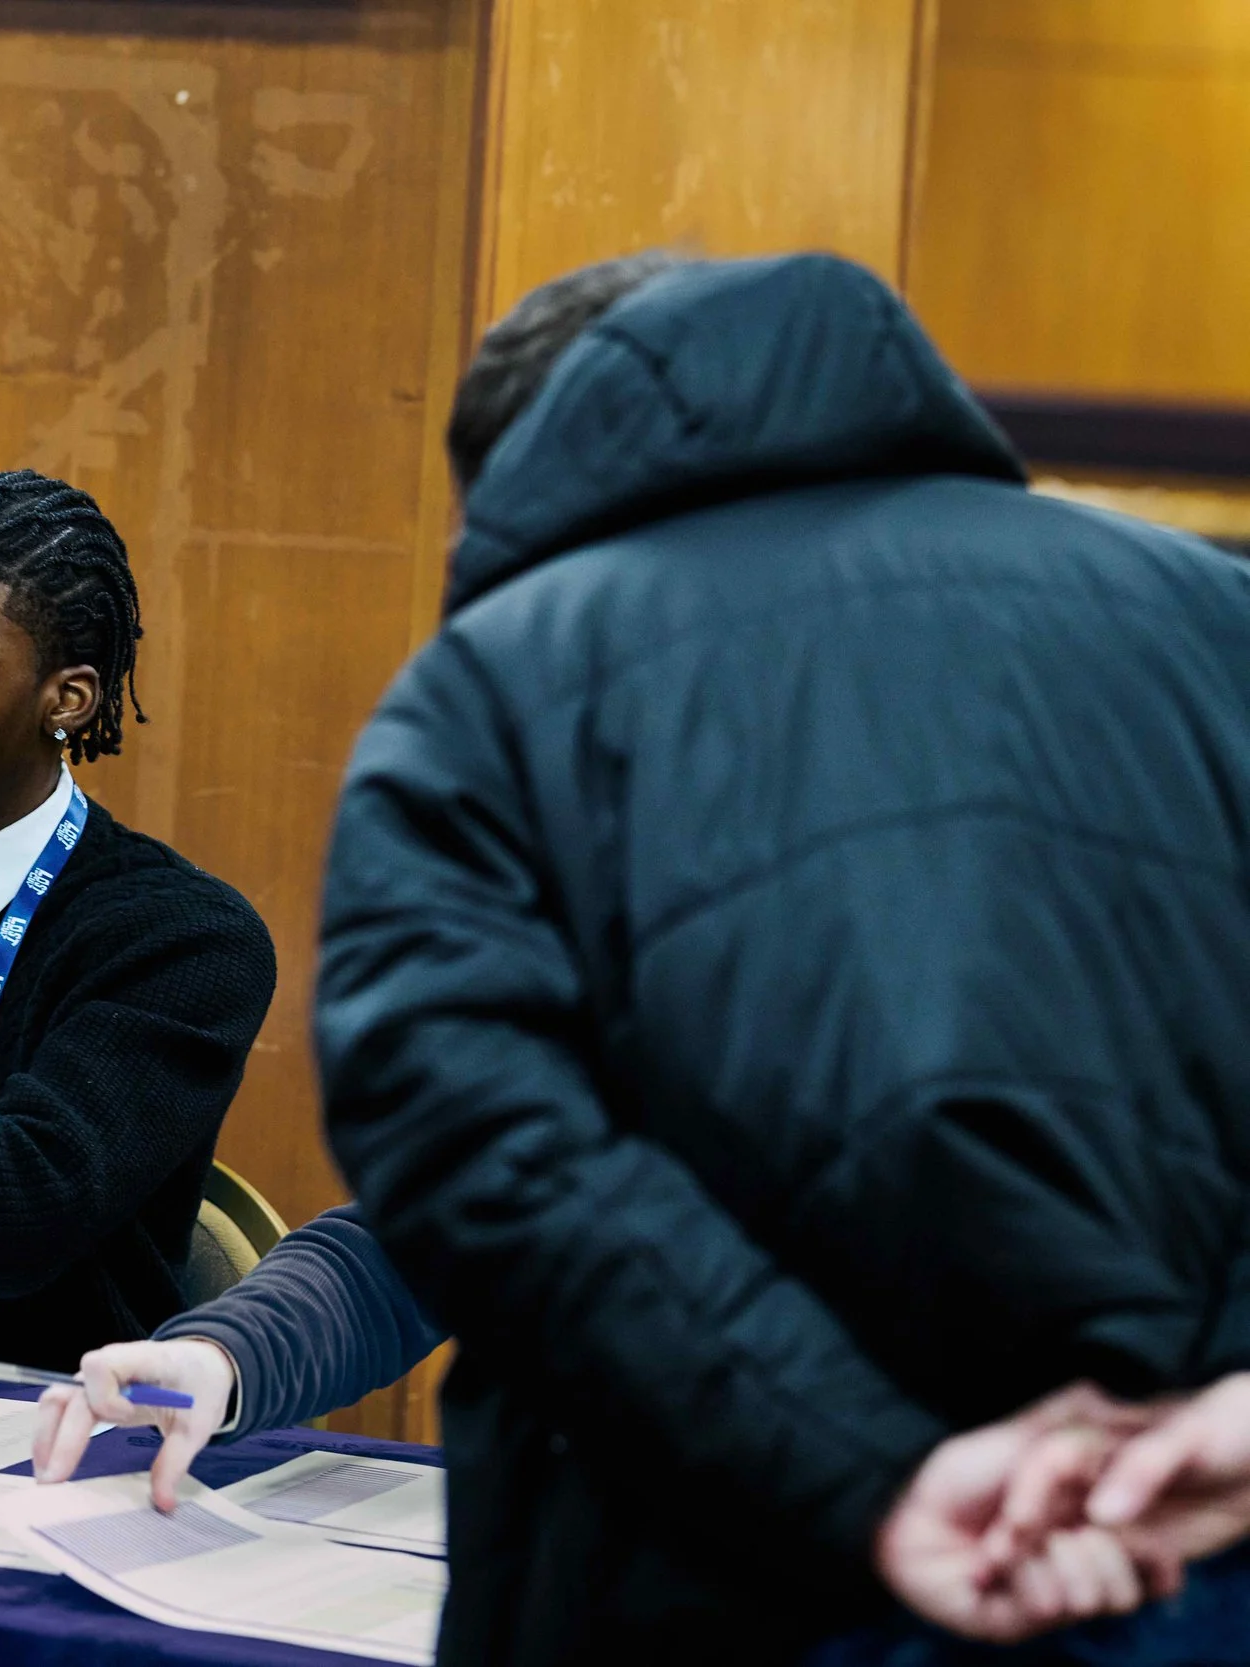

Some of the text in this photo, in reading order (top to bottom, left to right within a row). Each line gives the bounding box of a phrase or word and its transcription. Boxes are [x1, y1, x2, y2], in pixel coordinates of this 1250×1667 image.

[61, 820, 80, 851] LOST
[33, 868, 54, 896] LOST
[6, 917, 27, 947] LOST
